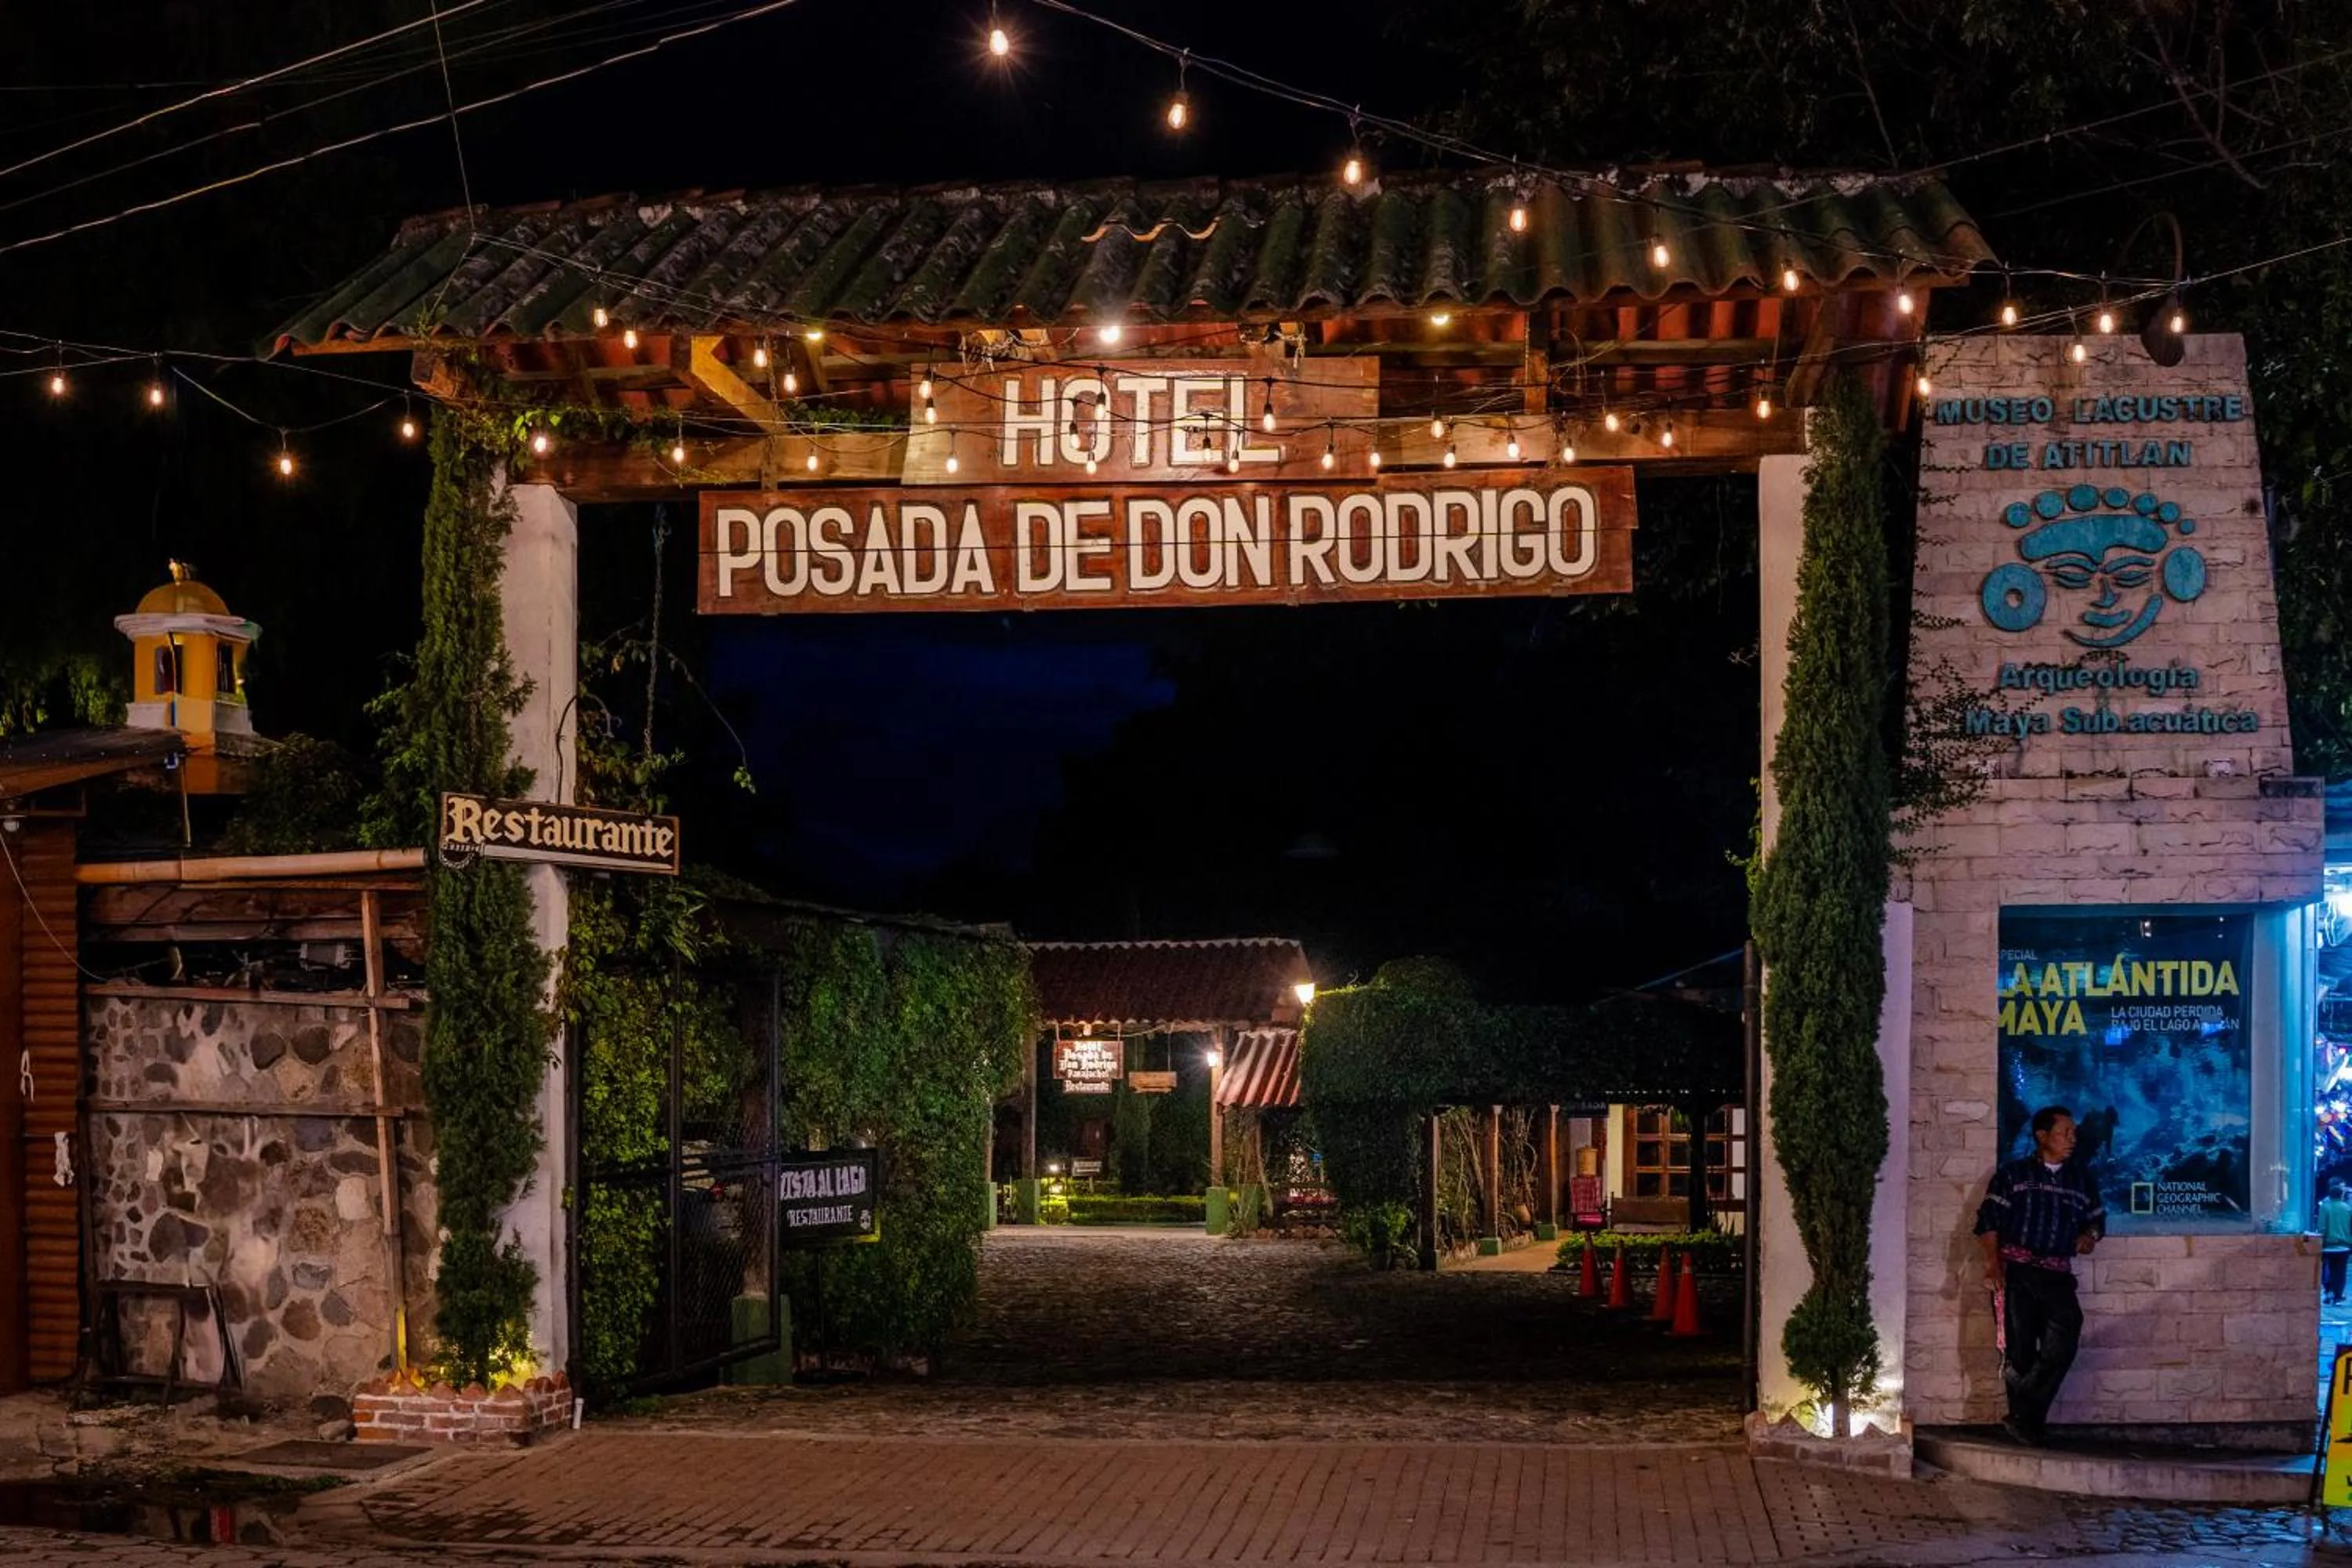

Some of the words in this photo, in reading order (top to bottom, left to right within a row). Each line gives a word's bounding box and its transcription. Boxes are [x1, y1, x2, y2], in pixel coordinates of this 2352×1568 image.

[1004, 376, 1280, 466] HOTEL
[1936, 397, 2054, 426] MUSEO
[1987, 441, 2030, 469] DE
[2043, 440, 2192, 468] ATITLAN
[717, 506, 995, 597] POSADA
[1016, 500, 1113, 593] DE
[1127, 495, 1272, 591] DON
[1288, 488, 1596, 585] RODRIGO
[1965, 710, 2049, 740] Maya
[446, 798, 673, 857] Restaurante
[1997, 950, 2038, 960] PECIAL
[2040, 953, 2240, 996] ATLÁNTIDA
[1998, 1000, 2087, 1036] MAYA
[2111, 1006, 2126, 1018] LA
[2129, 1006, 2171, 1018] CIUDAD
[2143, 1019, 2158, 1031] EL
[2160, 1019, 2190, 1031] LAGO
[2157, 1192, 2221, 1203] GEOGRAPHIC
[2158, 1182, 2207, 1191] NATIONAL
[786, 1205, 854, 1228] RESTAURANTE
